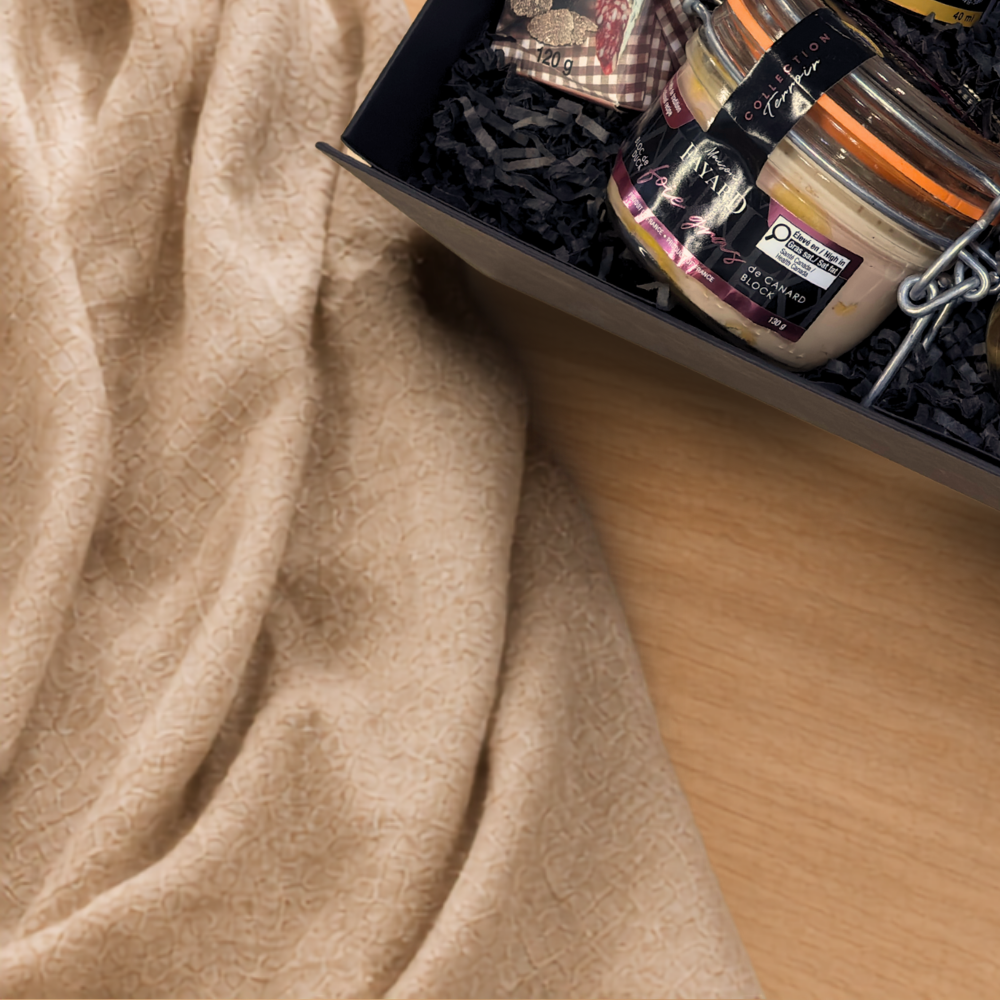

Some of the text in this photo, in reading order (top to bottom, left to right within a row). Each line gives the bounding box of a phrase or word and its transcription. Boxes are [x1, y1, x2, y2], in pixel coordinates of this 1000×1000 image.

[953, 11, 964, 20] 40
[537, 45, 573, 76] 120 g
[743, 32, 832, 122] COLLECTION
[763, 58, 821, 118] Terroir
[679, 141, 753, 215] FAYARD
[775, 253, 809, 277] Health Canada
[780, 248, 795, 260] Santé
[787, 240, 838, 275] Gras Sat fat
[793, 231, 846, 266] Élevé en High in
[740, 273, 775, 300] BLOCK
[748, 265, 806, 304] de CANARD
